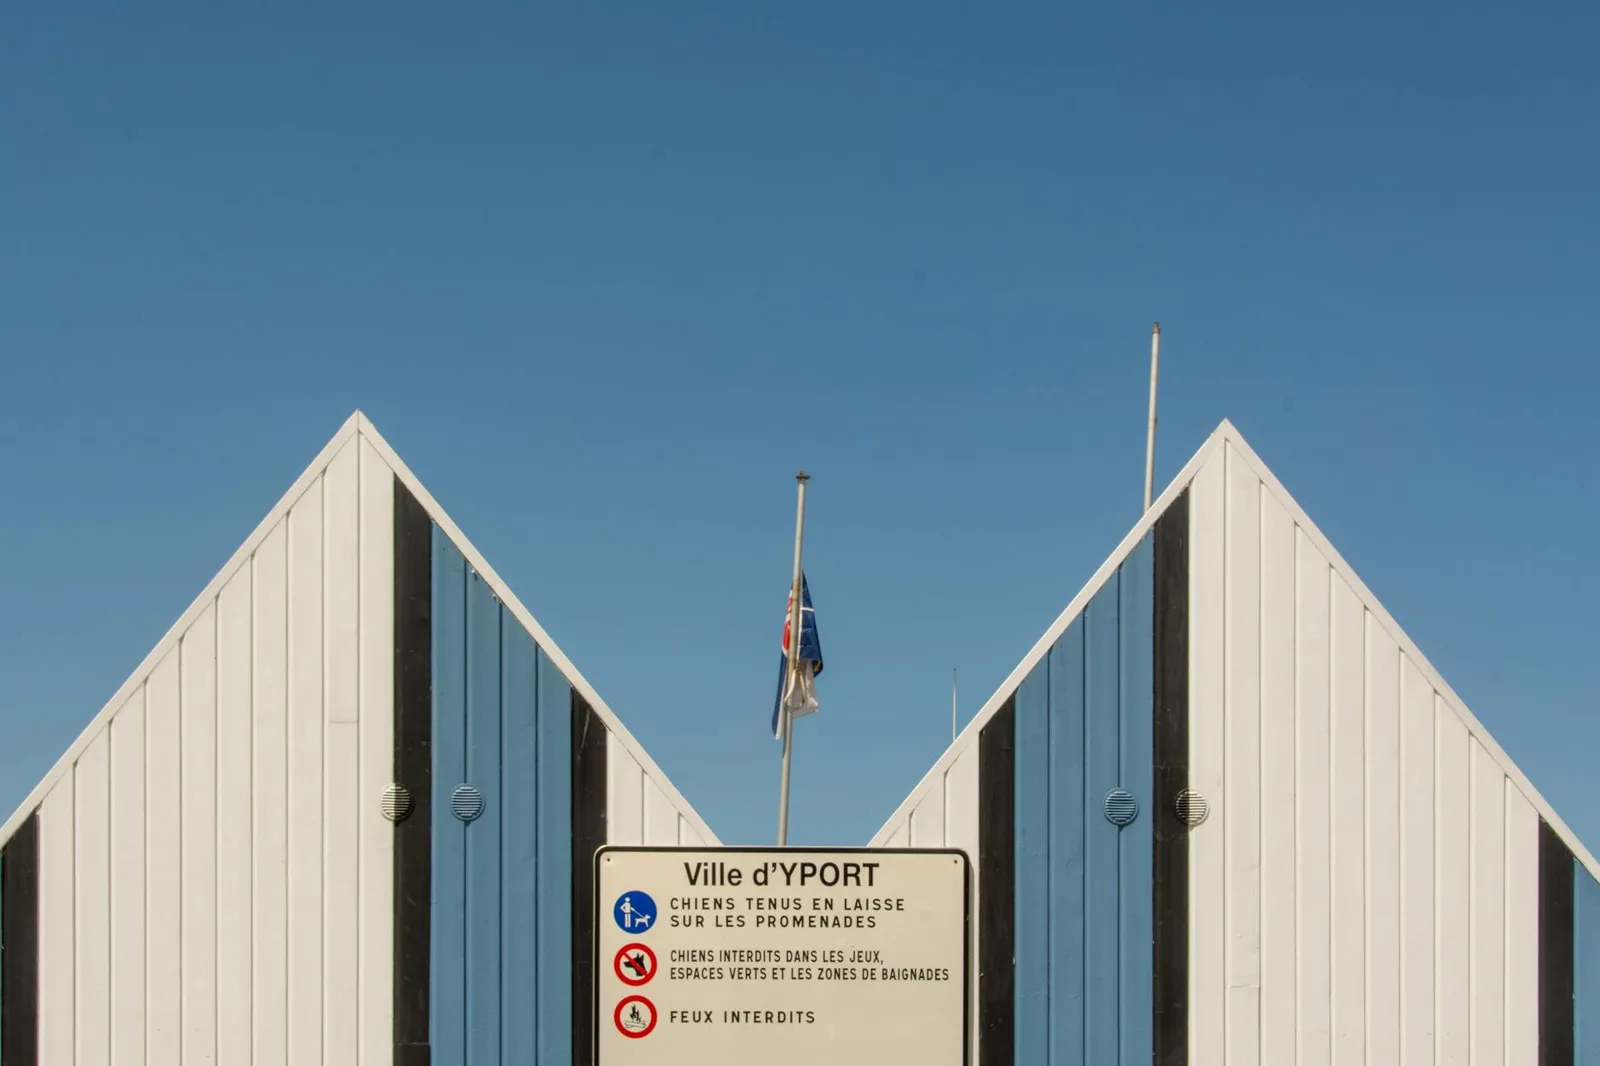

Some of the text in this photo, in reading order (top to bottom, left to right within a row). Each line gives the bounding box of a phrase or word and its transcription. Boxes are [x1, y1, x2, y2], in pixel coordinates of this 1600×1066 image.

[684, 862, 880, 887] Ville d'YPORT
[670, 898, 905, 912] CHIENS TENUS EN LAISSE
[670, 915, 876, 929] SUR LES PROMENADES
[670, 950, 884, 966] CHIENS INTERDITS DANS LES JEUX,
[670, 967, 950, 981] ESPACES VERTS ET LES ZONES DE BAIGNADES
[670, 1010, 816, 1024] FEUX INTERDITS
